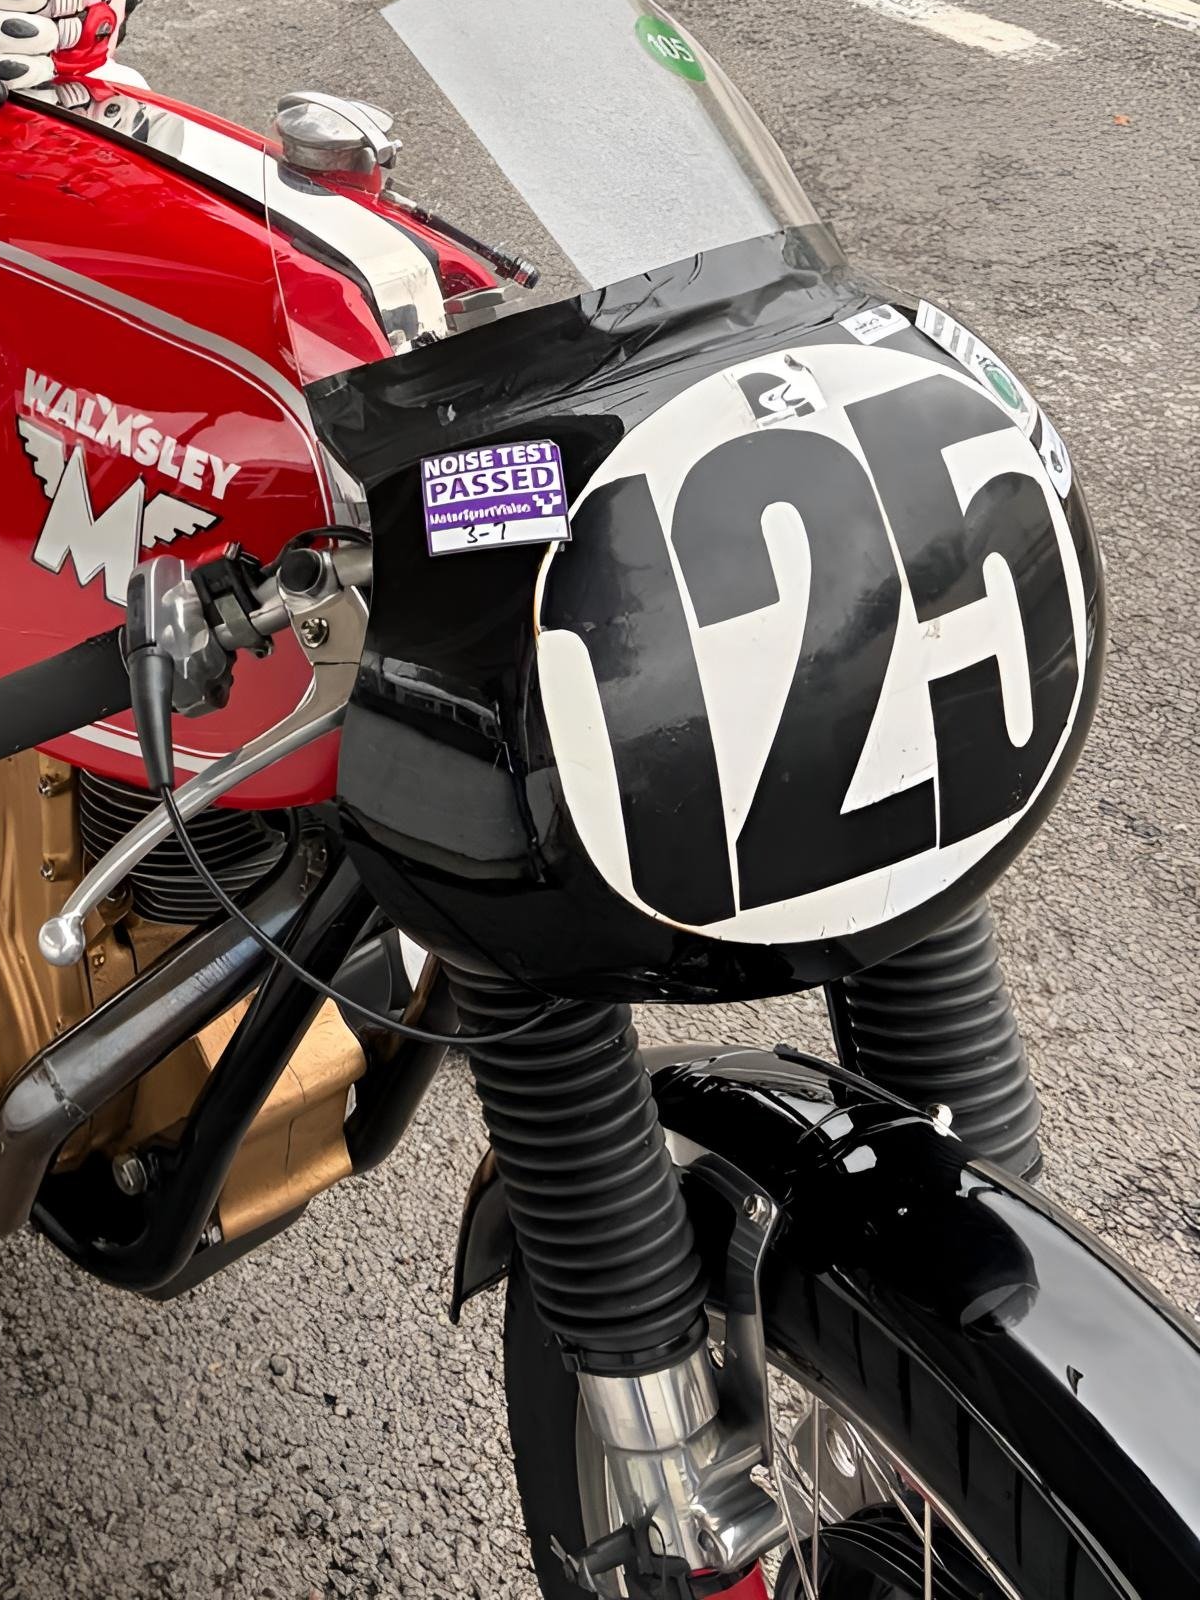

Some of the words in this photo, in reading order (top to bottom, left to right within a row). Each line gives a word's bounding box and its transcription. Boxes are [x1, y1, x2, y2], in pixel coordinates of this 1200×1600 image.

[23, 367, 242, 501] WALMSLEY
[424, 450, 495, 479] NOISE
[496, 443, 553, 466] TEST
[429, 466, 555, 504] PASSED
[542, 373, 1084, 927] 125
